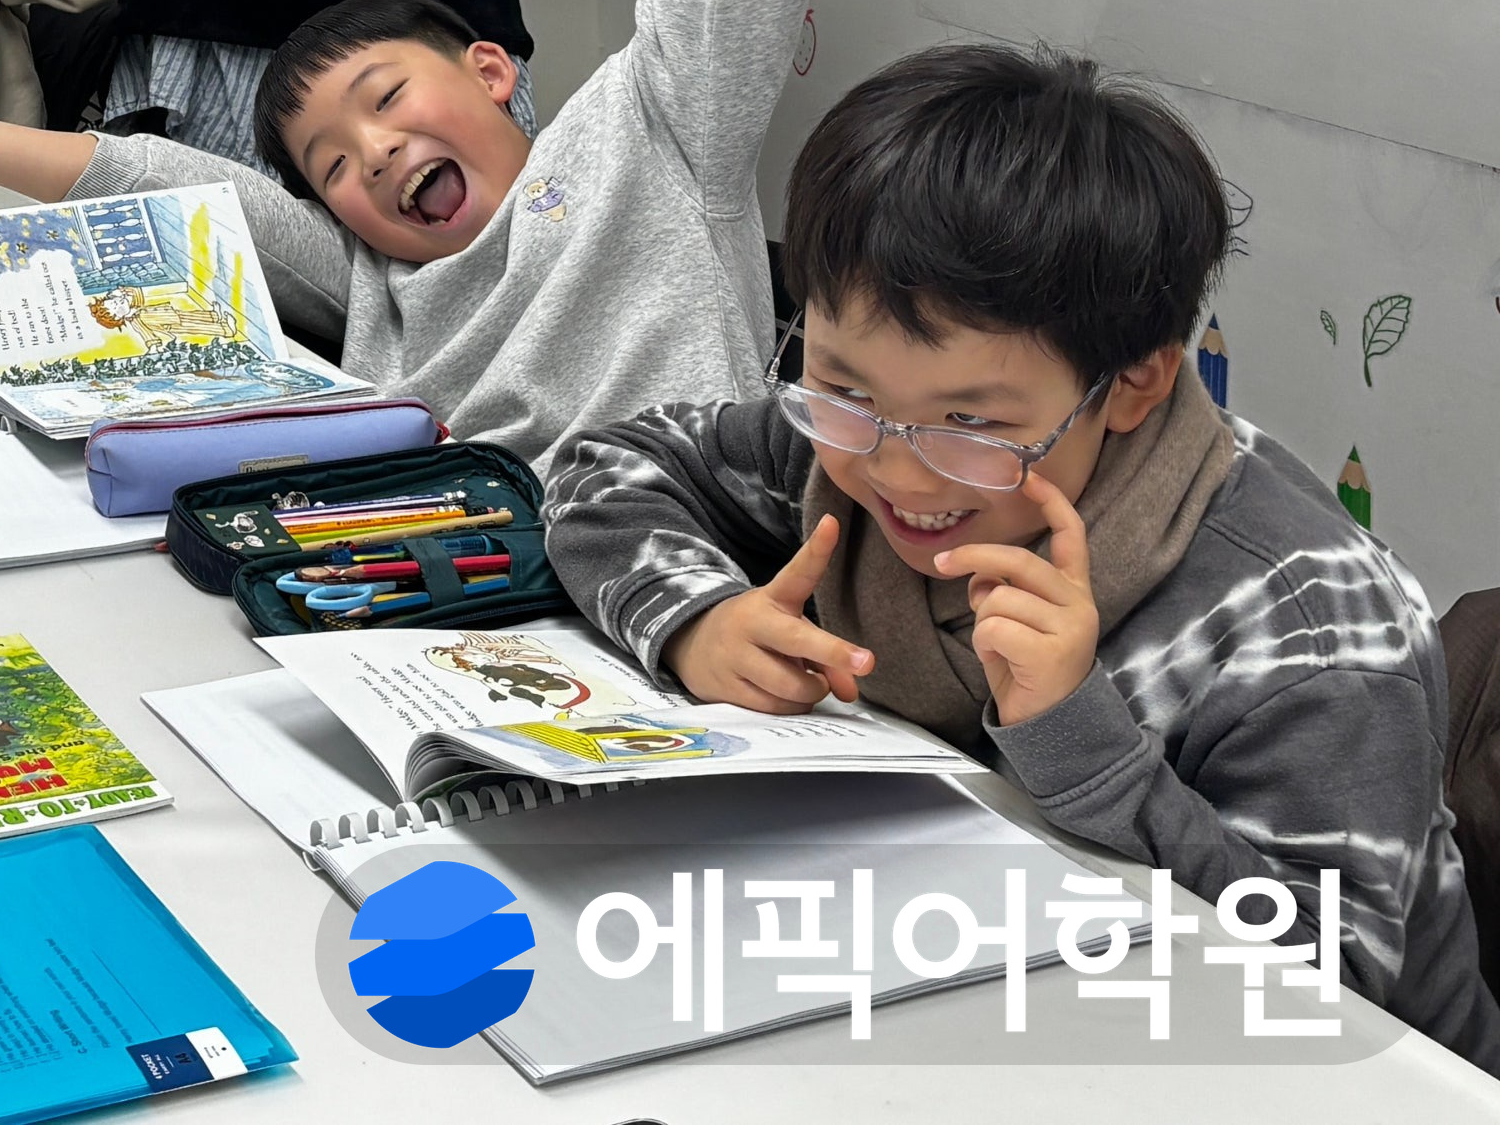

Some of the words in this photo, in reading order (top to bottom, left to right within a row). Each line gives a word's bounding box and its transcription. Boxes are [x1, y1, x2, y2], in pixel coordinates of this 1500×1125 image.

[13, 746, 48, 758] the
[47, 739, 87, 751] and
[80, 782, 157, 809] READY
[33, 796, 81, 819] TO
[140, 1052, 161, 1075] POCKET
